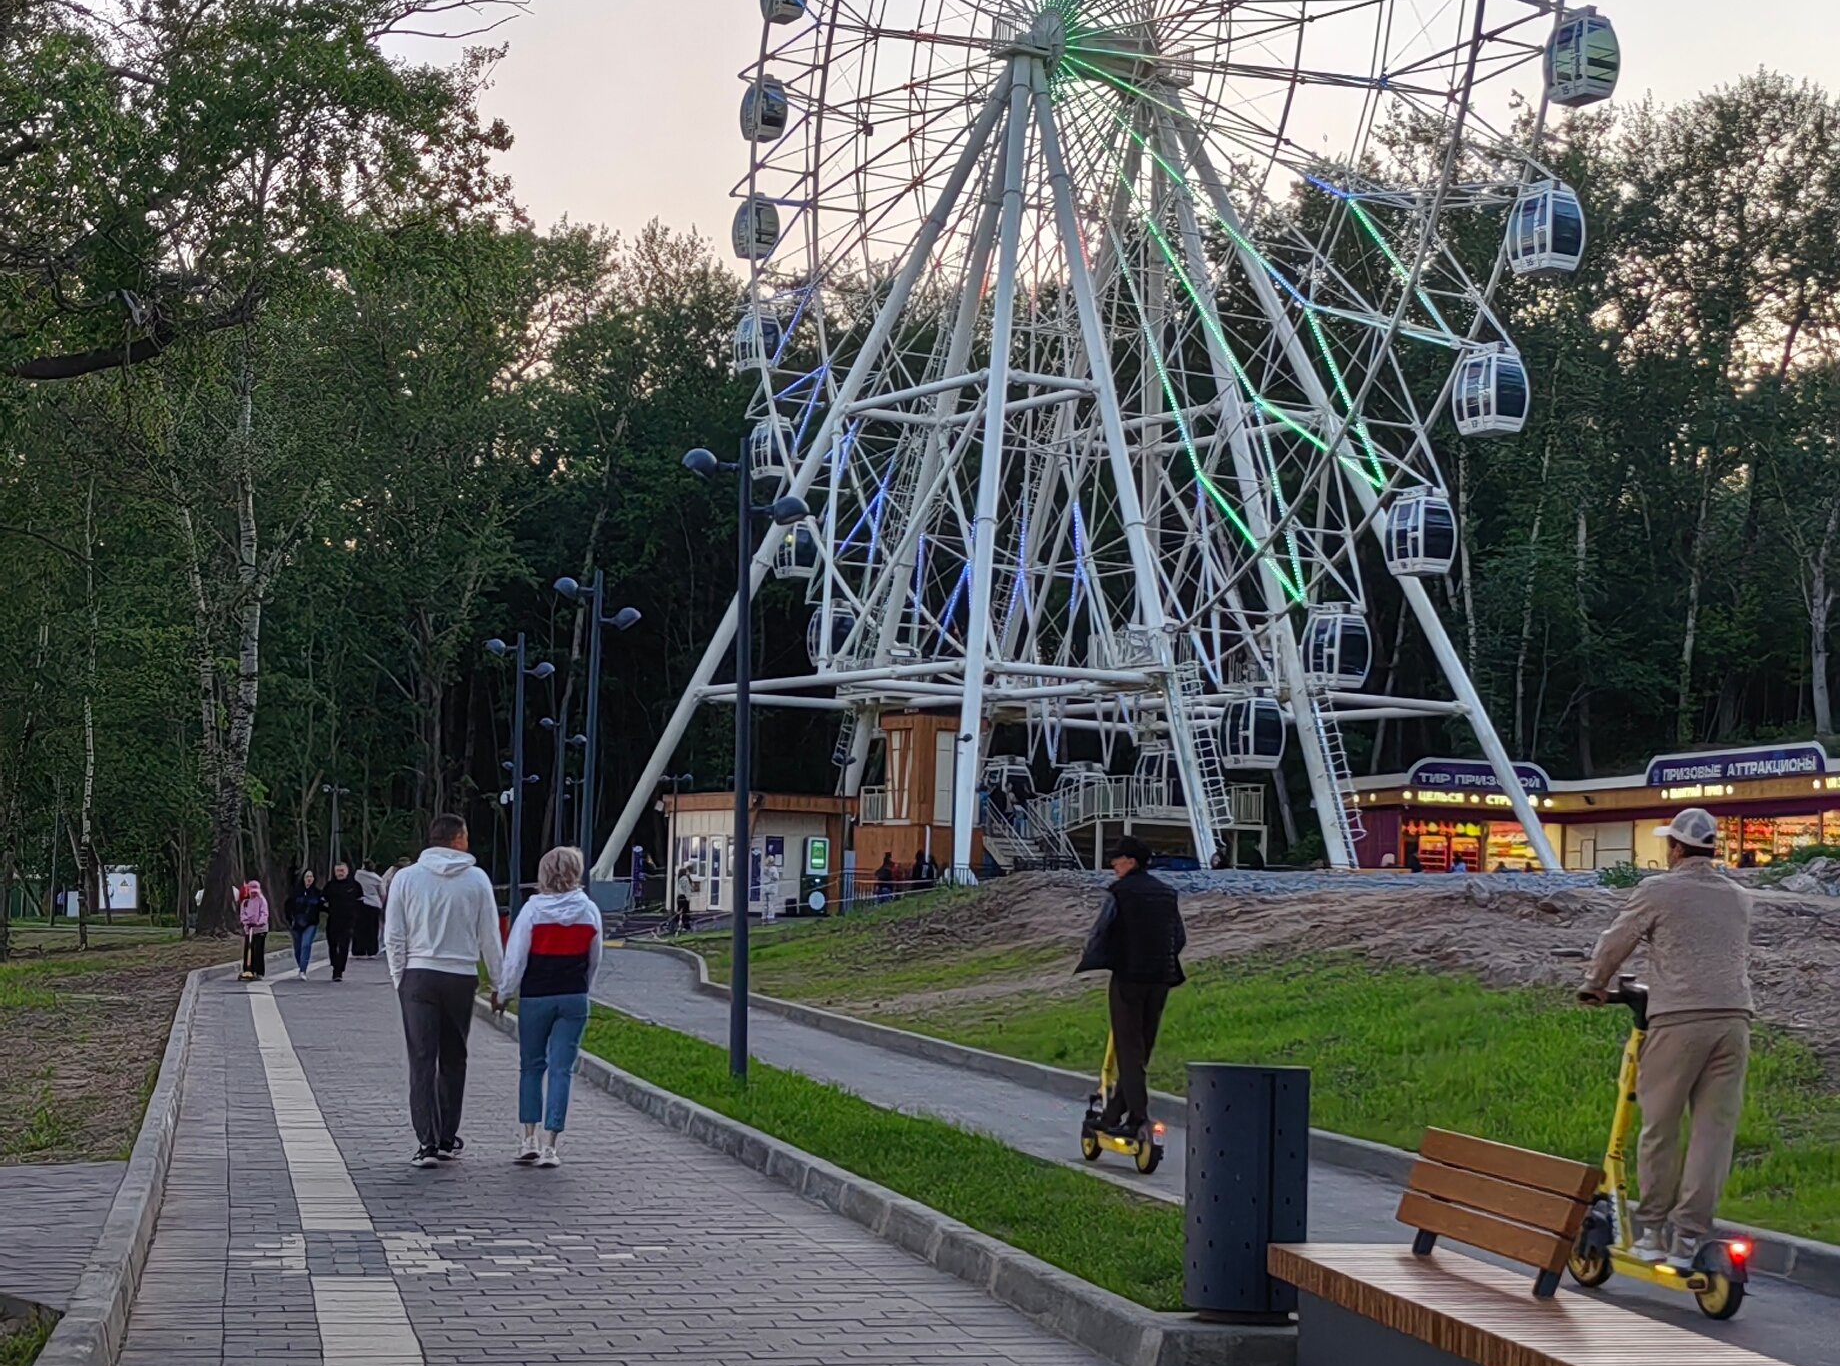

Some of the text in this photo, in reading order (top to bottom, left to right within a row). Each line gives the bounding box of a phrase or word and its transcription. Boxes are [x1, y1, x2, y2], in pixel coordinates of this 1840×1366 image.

[1663, 755, 1817, 782] ПРИЗОВЫЕ АТТРАКЦИОНЫ
[1418, 772, 1540, 788] ТИР ПРИЗОЙ
